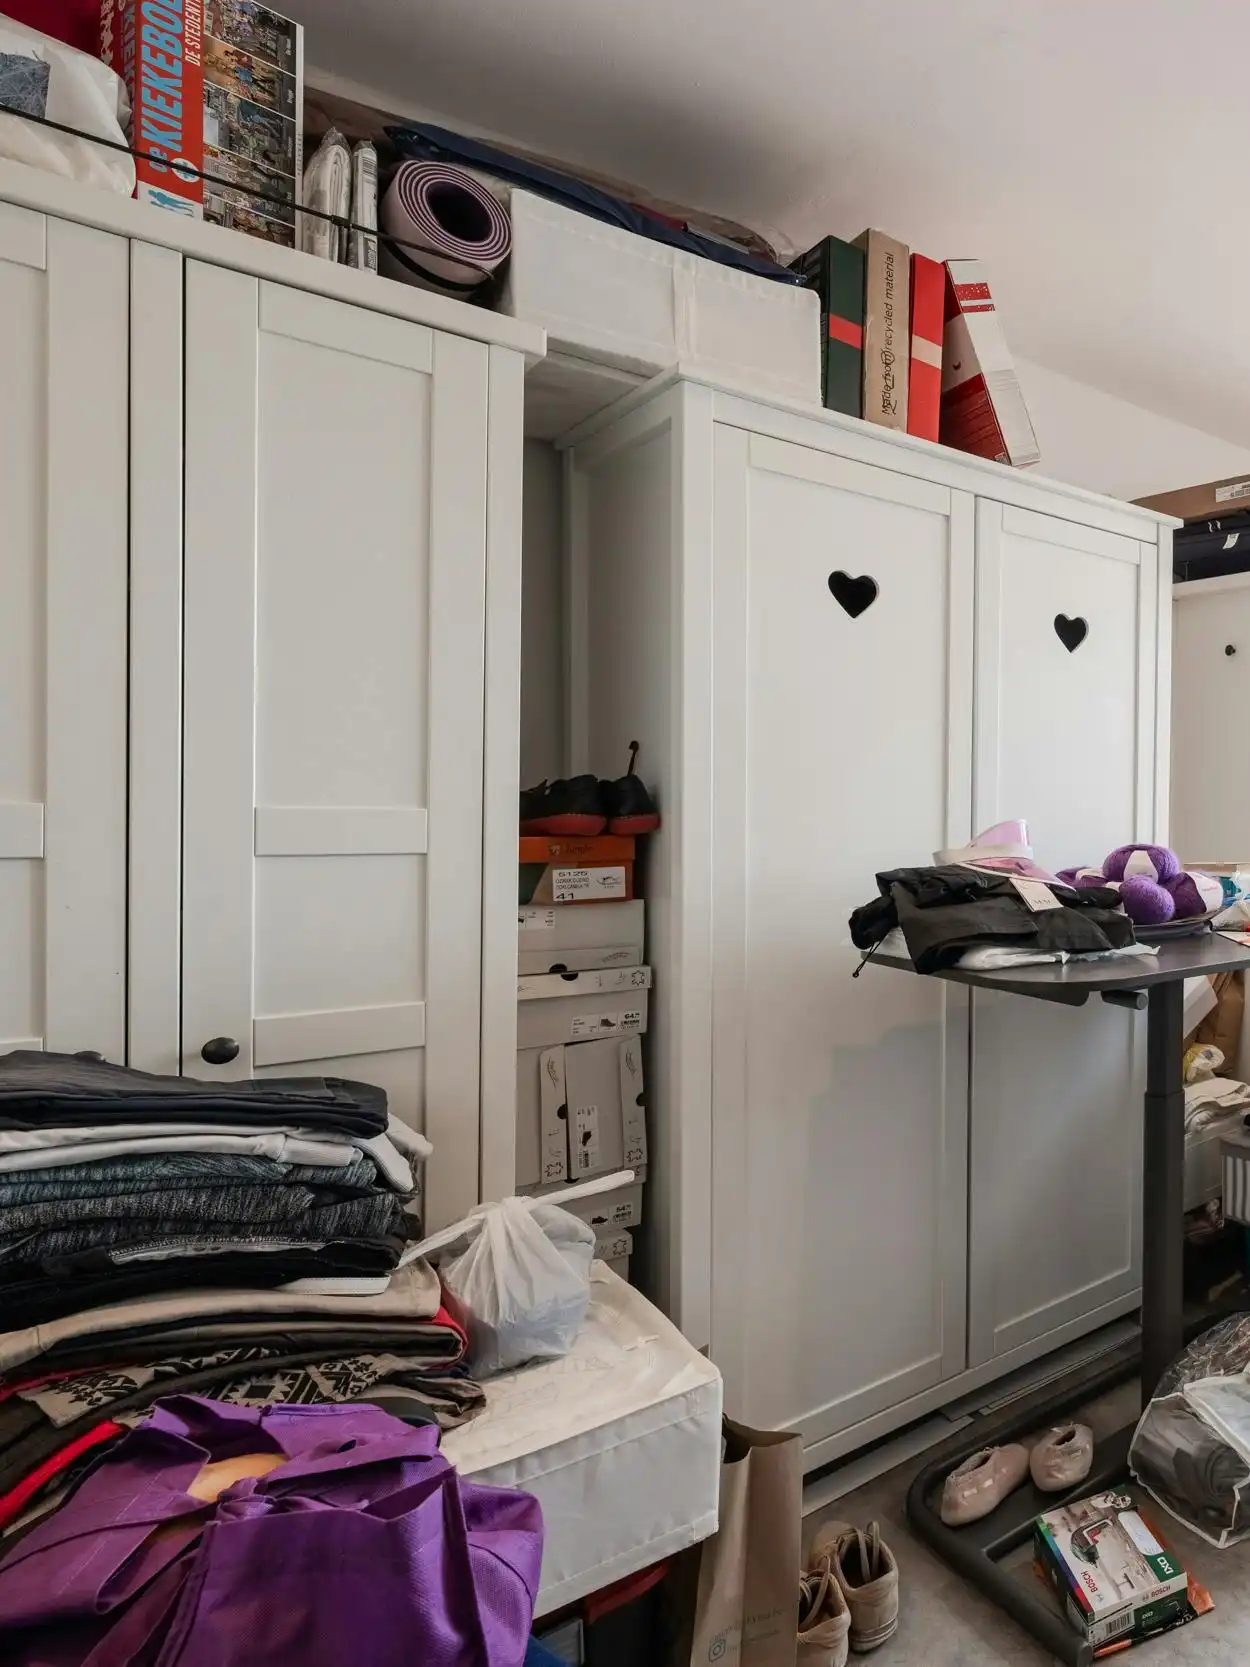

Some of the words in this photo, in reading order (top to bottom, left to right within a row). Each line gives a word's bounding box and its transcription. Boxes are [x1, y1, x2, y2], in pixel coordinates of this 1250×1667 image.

[185, 50, 200, 67] DE
[884, 252, 894, 300] material
[884, 302, 894, 351] recycled
[555, 892, 574, 900] 41
[1157, 1556, 1174, 1575] IXO
[1081, 1570, 1098, 1594] BOSCH
[1151, 1584, 1171, 1599] BOSCH
